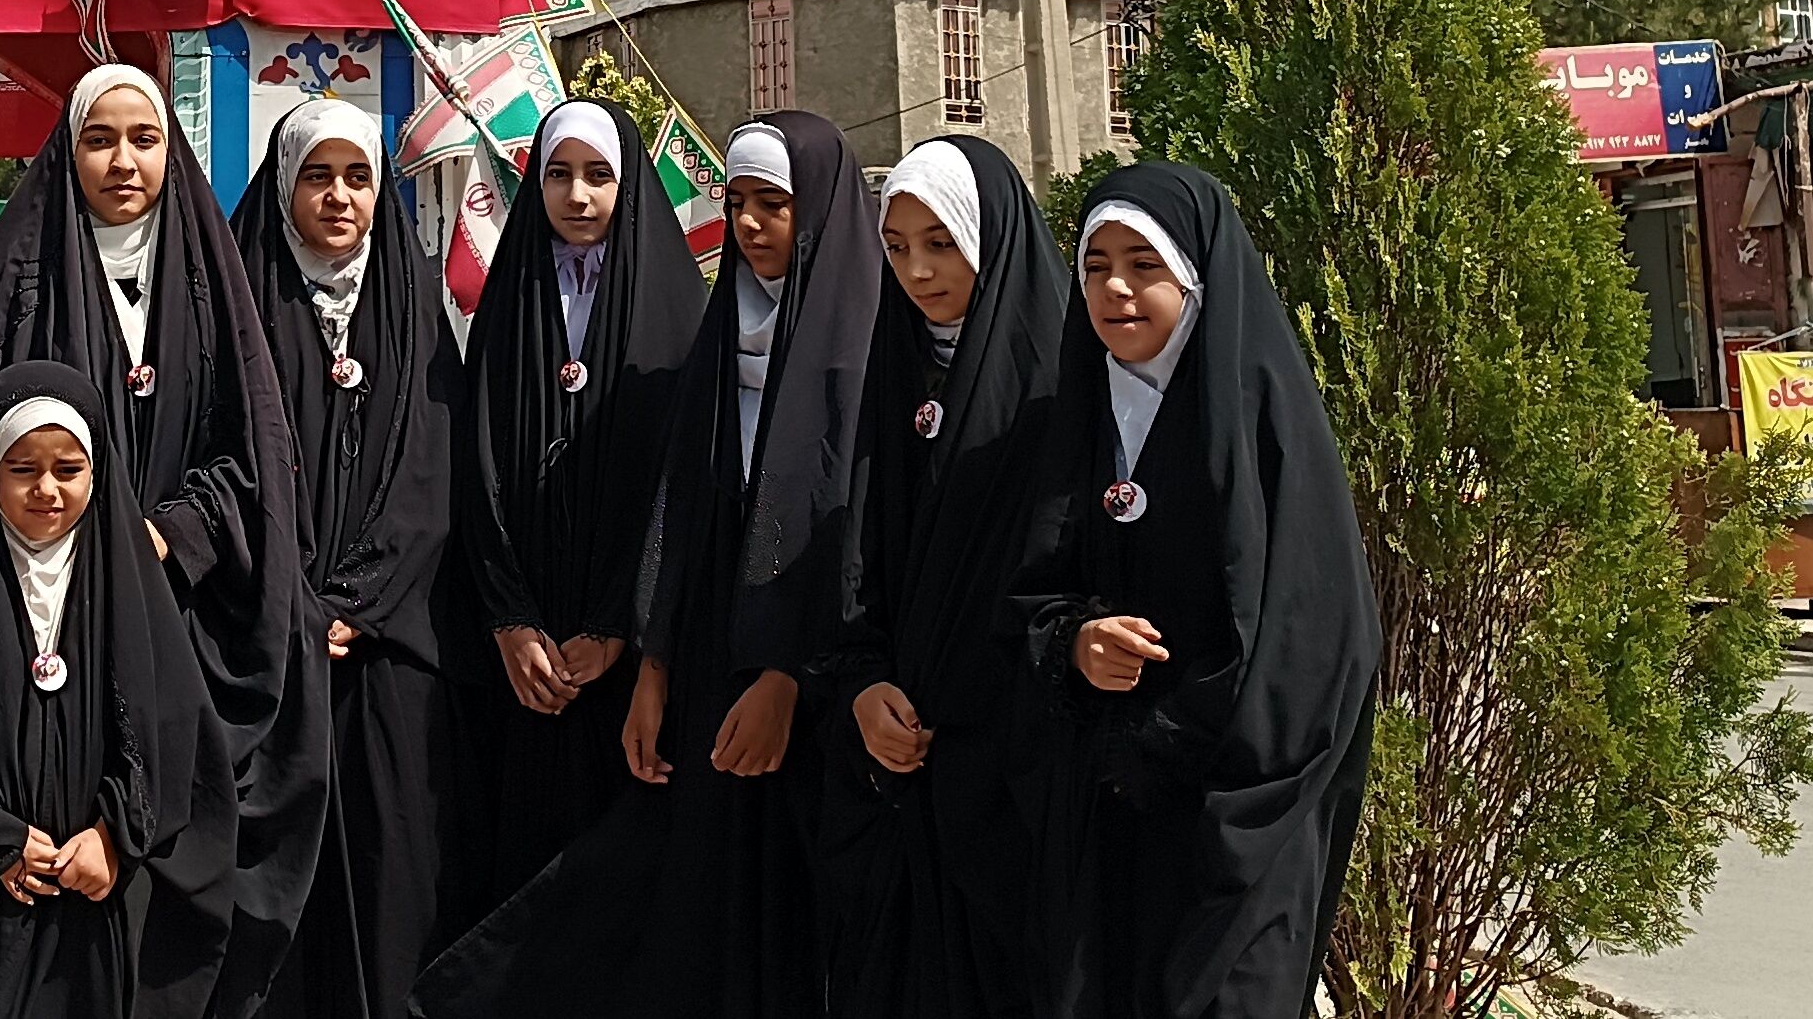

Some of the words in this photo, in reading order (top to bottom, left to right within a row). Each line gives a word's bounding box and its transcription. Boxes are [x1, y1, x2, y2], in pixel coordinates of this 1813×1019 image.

[1658, 48, 1711, 65] خدمات
[1538, 54, 1649, 99] موبای
[1684, 84, 1692, 99] و
